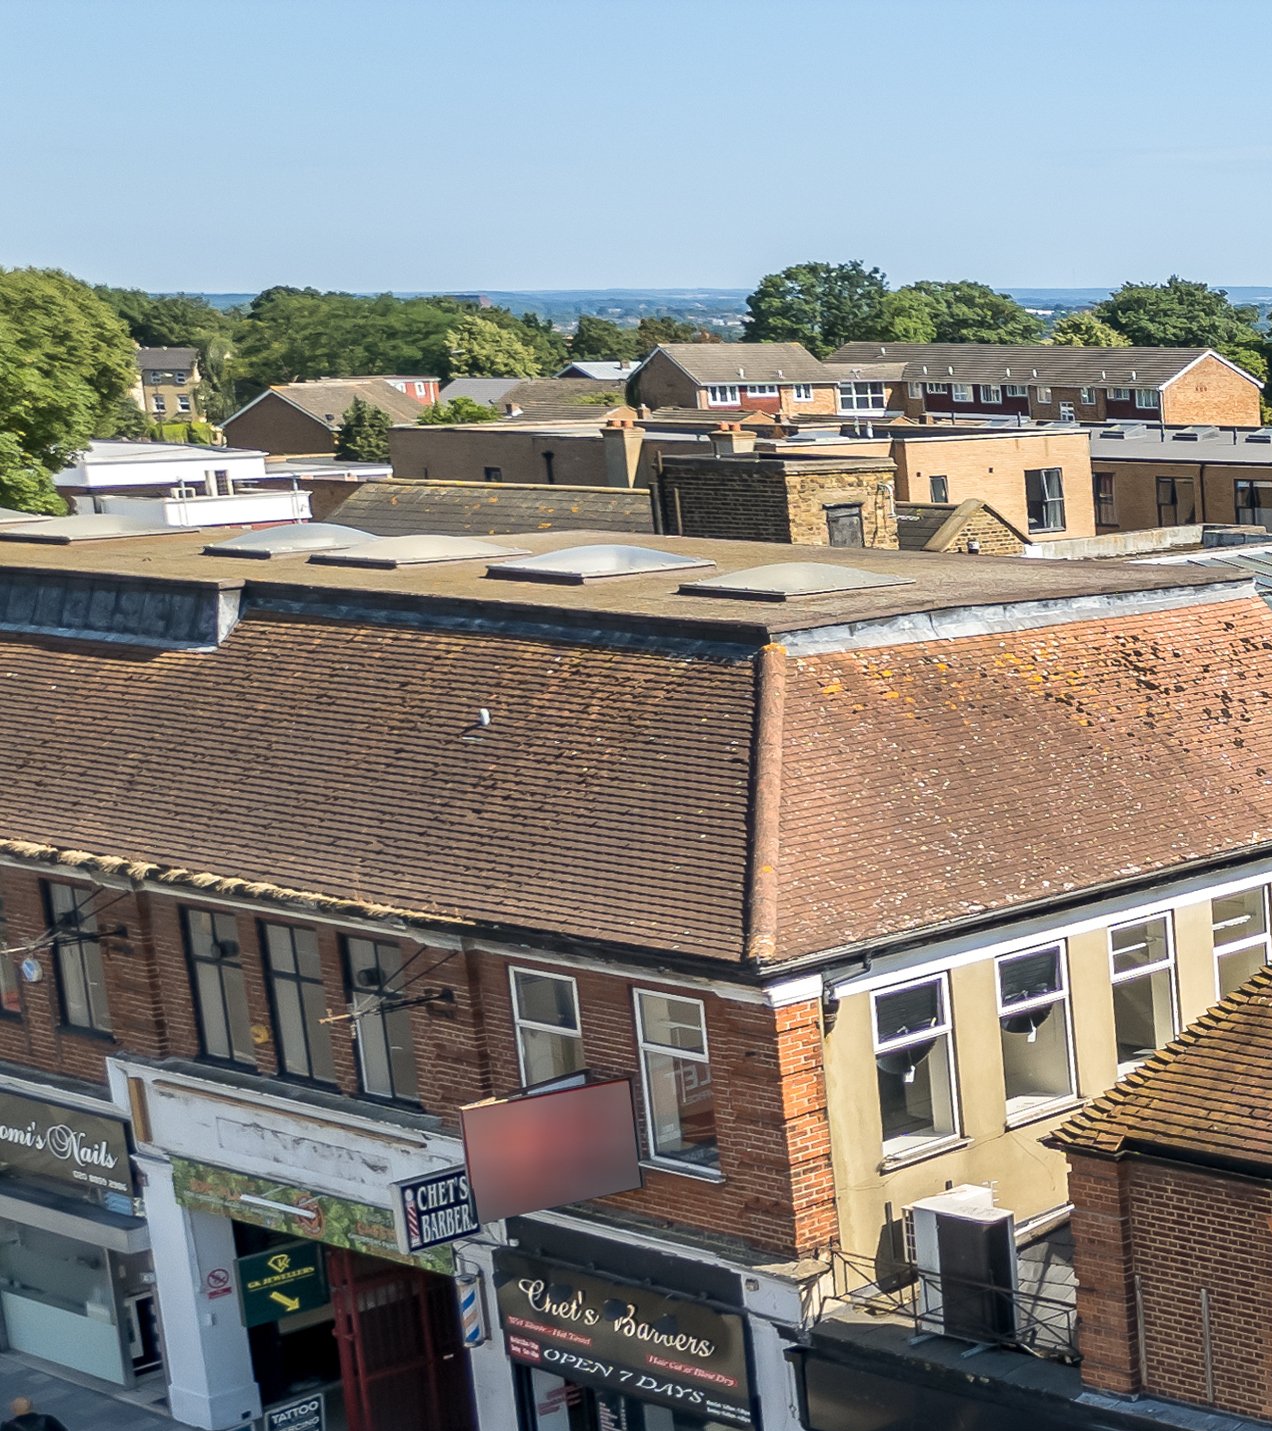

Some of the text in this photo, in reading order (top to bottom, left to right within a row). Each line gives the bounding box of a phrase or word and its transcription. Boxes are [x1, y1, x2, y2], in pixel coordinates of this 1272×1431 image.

[47, 1124, 118, 1169] Nails
[417, 1176, 469, 1211] CHET'S
[421, 1204, 478, 1243] BARBER
[544, 1349, 705, 1403] OPEN 7 DAYS
[271, 1401, 319, 1424] TATTOO
